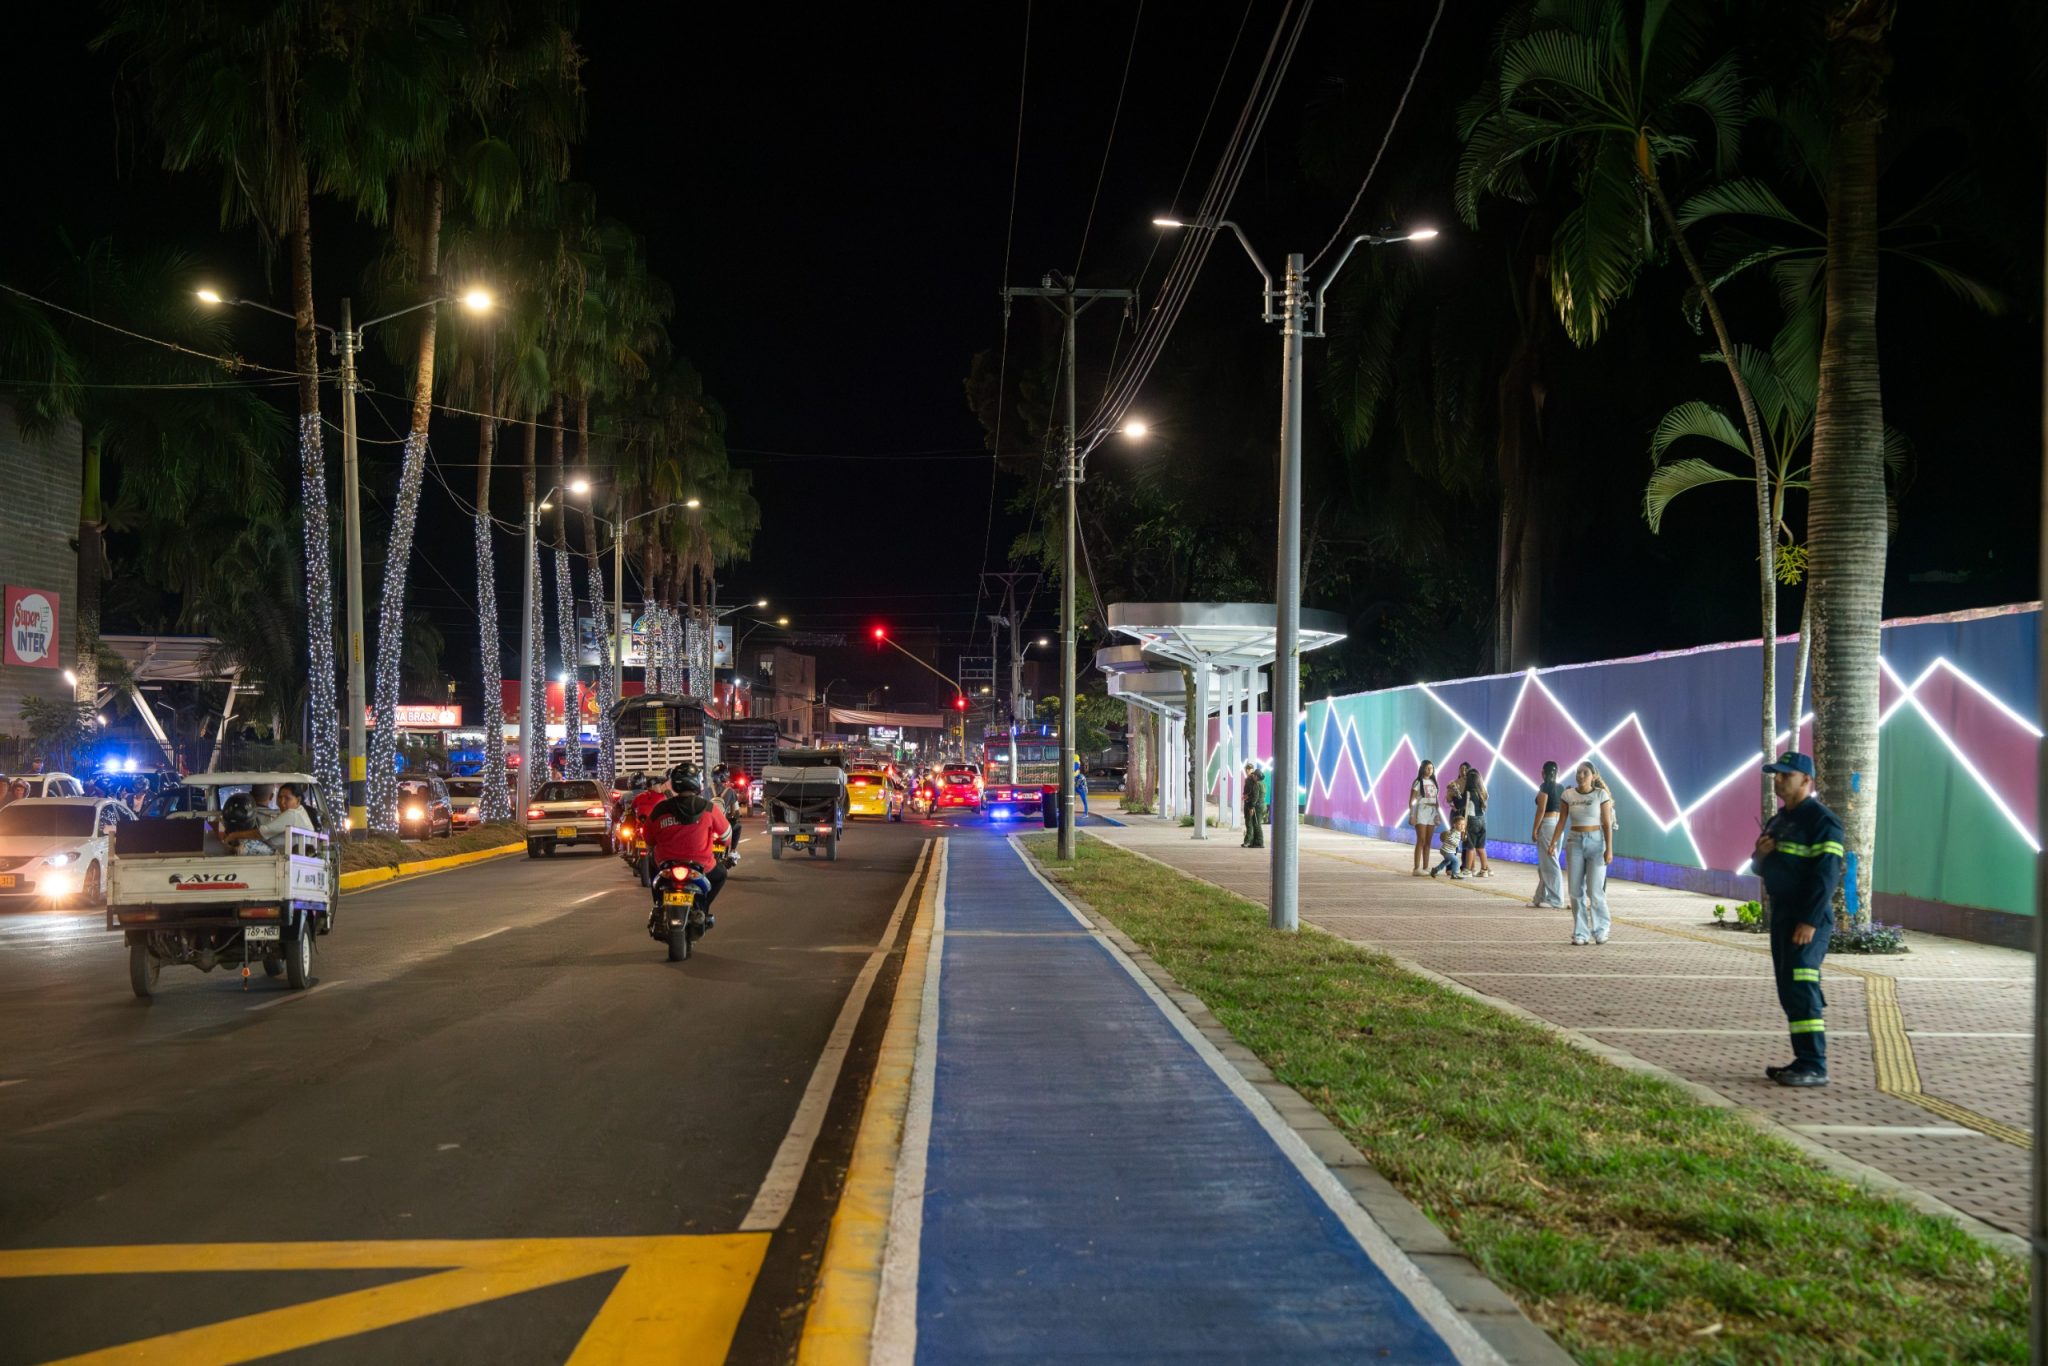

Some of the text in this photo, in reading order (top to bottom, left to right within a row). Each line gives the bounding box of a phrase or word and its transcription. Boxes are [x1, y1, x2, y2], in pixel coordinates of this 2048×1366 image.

[15, 602, 40, 630] Super
[17, 630, 47, 656] INTER
[408, 711, 436, 722] BRASA
[185, 873, 237, 882] AYCO
